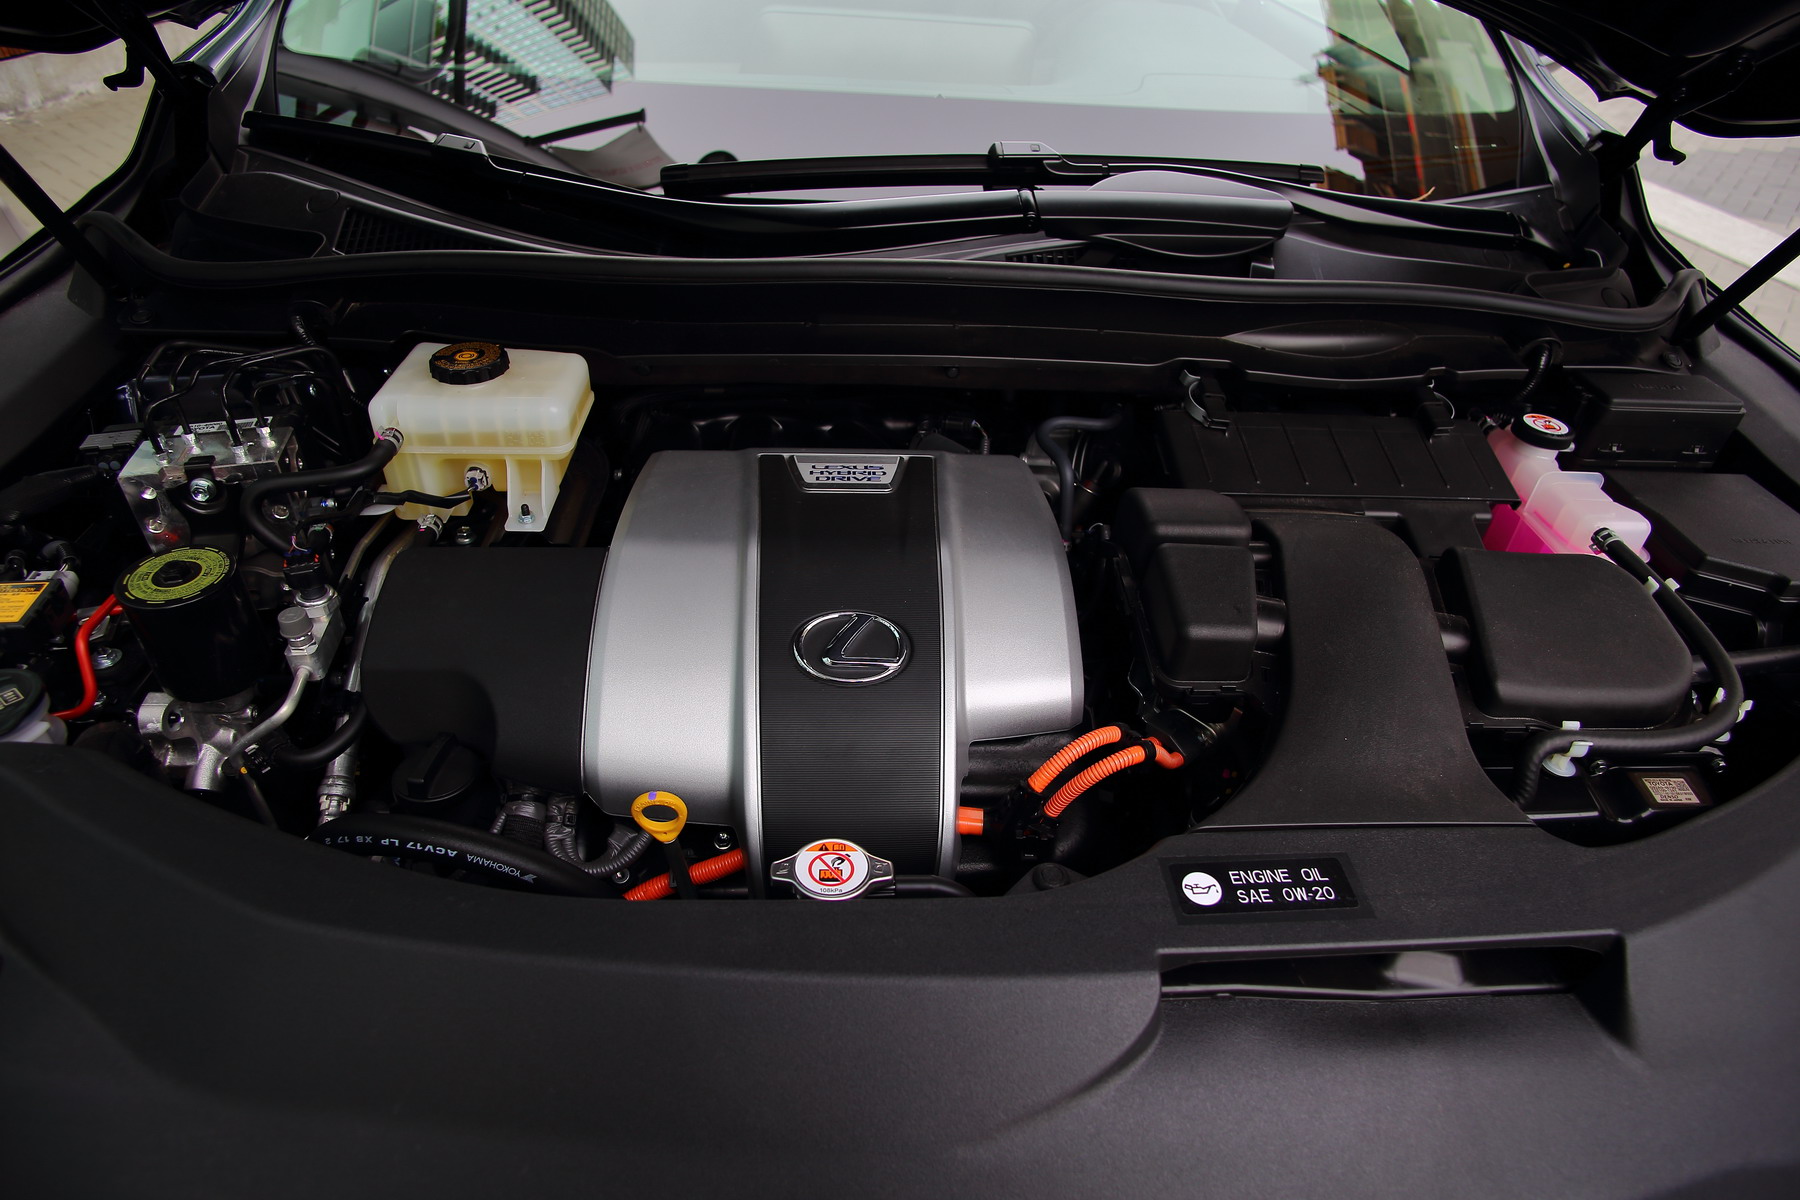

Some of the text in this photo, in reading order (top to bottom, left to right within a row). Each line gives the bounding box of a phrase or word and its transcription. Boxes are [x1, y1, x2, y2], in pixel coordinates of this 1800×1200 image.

[337, 835, 350, 844] 17
[380, 838, 400, 847] LP
[405, 841, 458, 857] ACV17
[466, 853, 522, 877] YOKOHAMA
[1228, 867, 1329, 885] ENGINE OIL
[1236, 886, 1336, 904] SAE 0W-20
